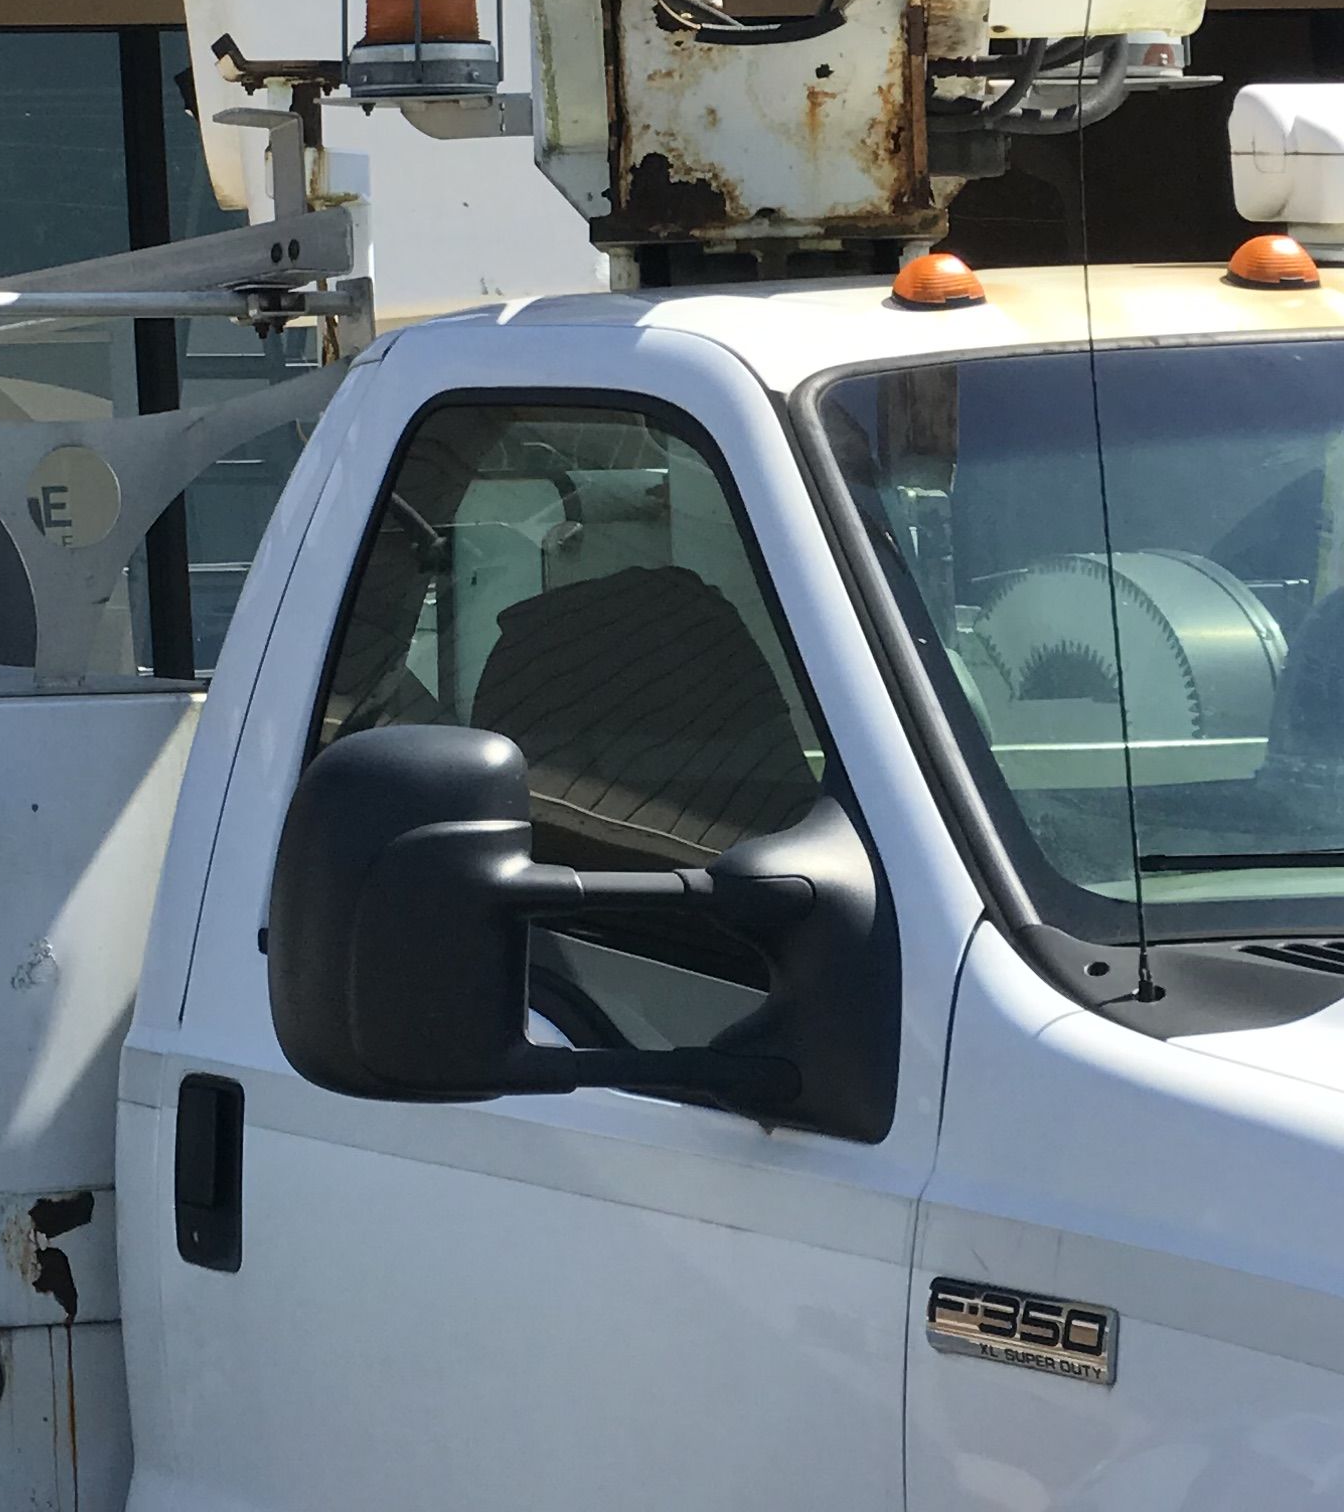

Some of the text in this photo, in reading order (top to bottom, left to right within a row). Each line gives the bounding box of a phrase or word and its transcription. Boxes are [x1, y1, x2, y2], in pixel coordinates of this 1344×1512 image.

[979, 1342, 1104, 1380] XL SUPER DUTY
